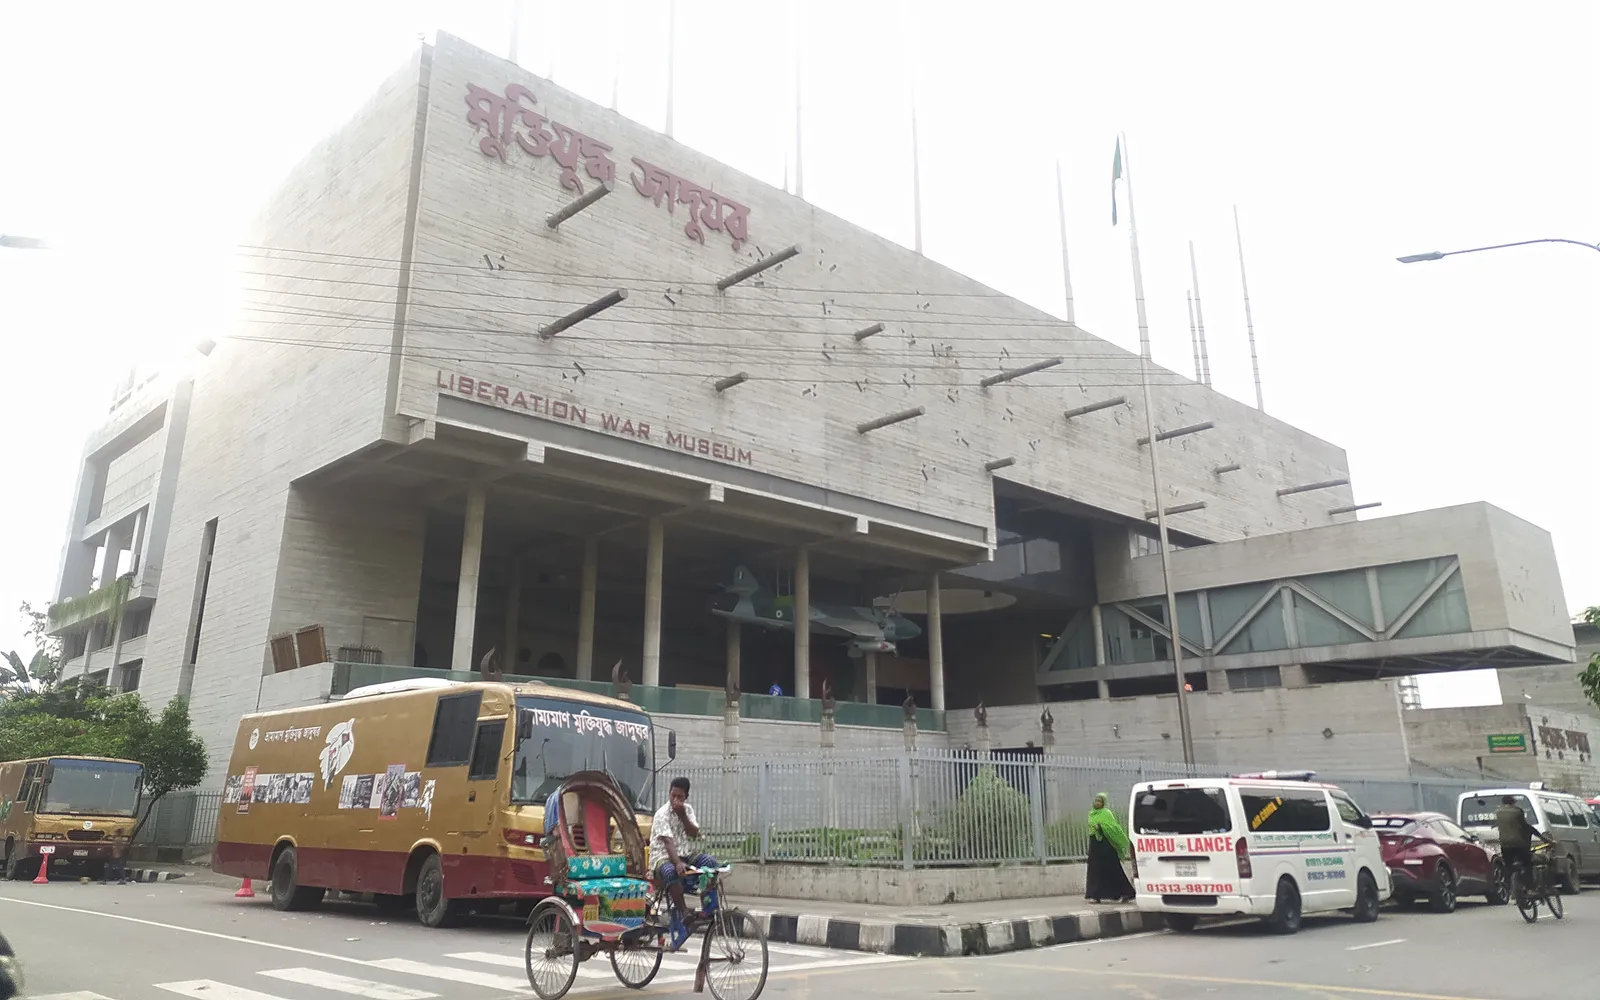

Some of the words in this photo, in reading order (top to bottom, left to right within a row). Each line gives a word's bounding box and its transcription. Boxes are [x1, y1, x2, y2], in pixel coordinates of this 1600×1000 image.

[464, 82, 616, 195] মুক্তিযুদ্ধ
[630, 156, 752, 252] জাদুঘর
[437, 369, 588, 424] LIBERATION
[601, 413, 651, 440] WAR
[666, 430, 753, 465] MUSEUM
[572, 709, 613, 738] মুক্তিযুদ্ধ
[614, 719, 649, 742] জাদুঘর
[1137, 838, 1175, 852] AMBU
[1186, 836, 1233, 852] LANCE
[1146, 883, 1233, 893] 01313-987700
